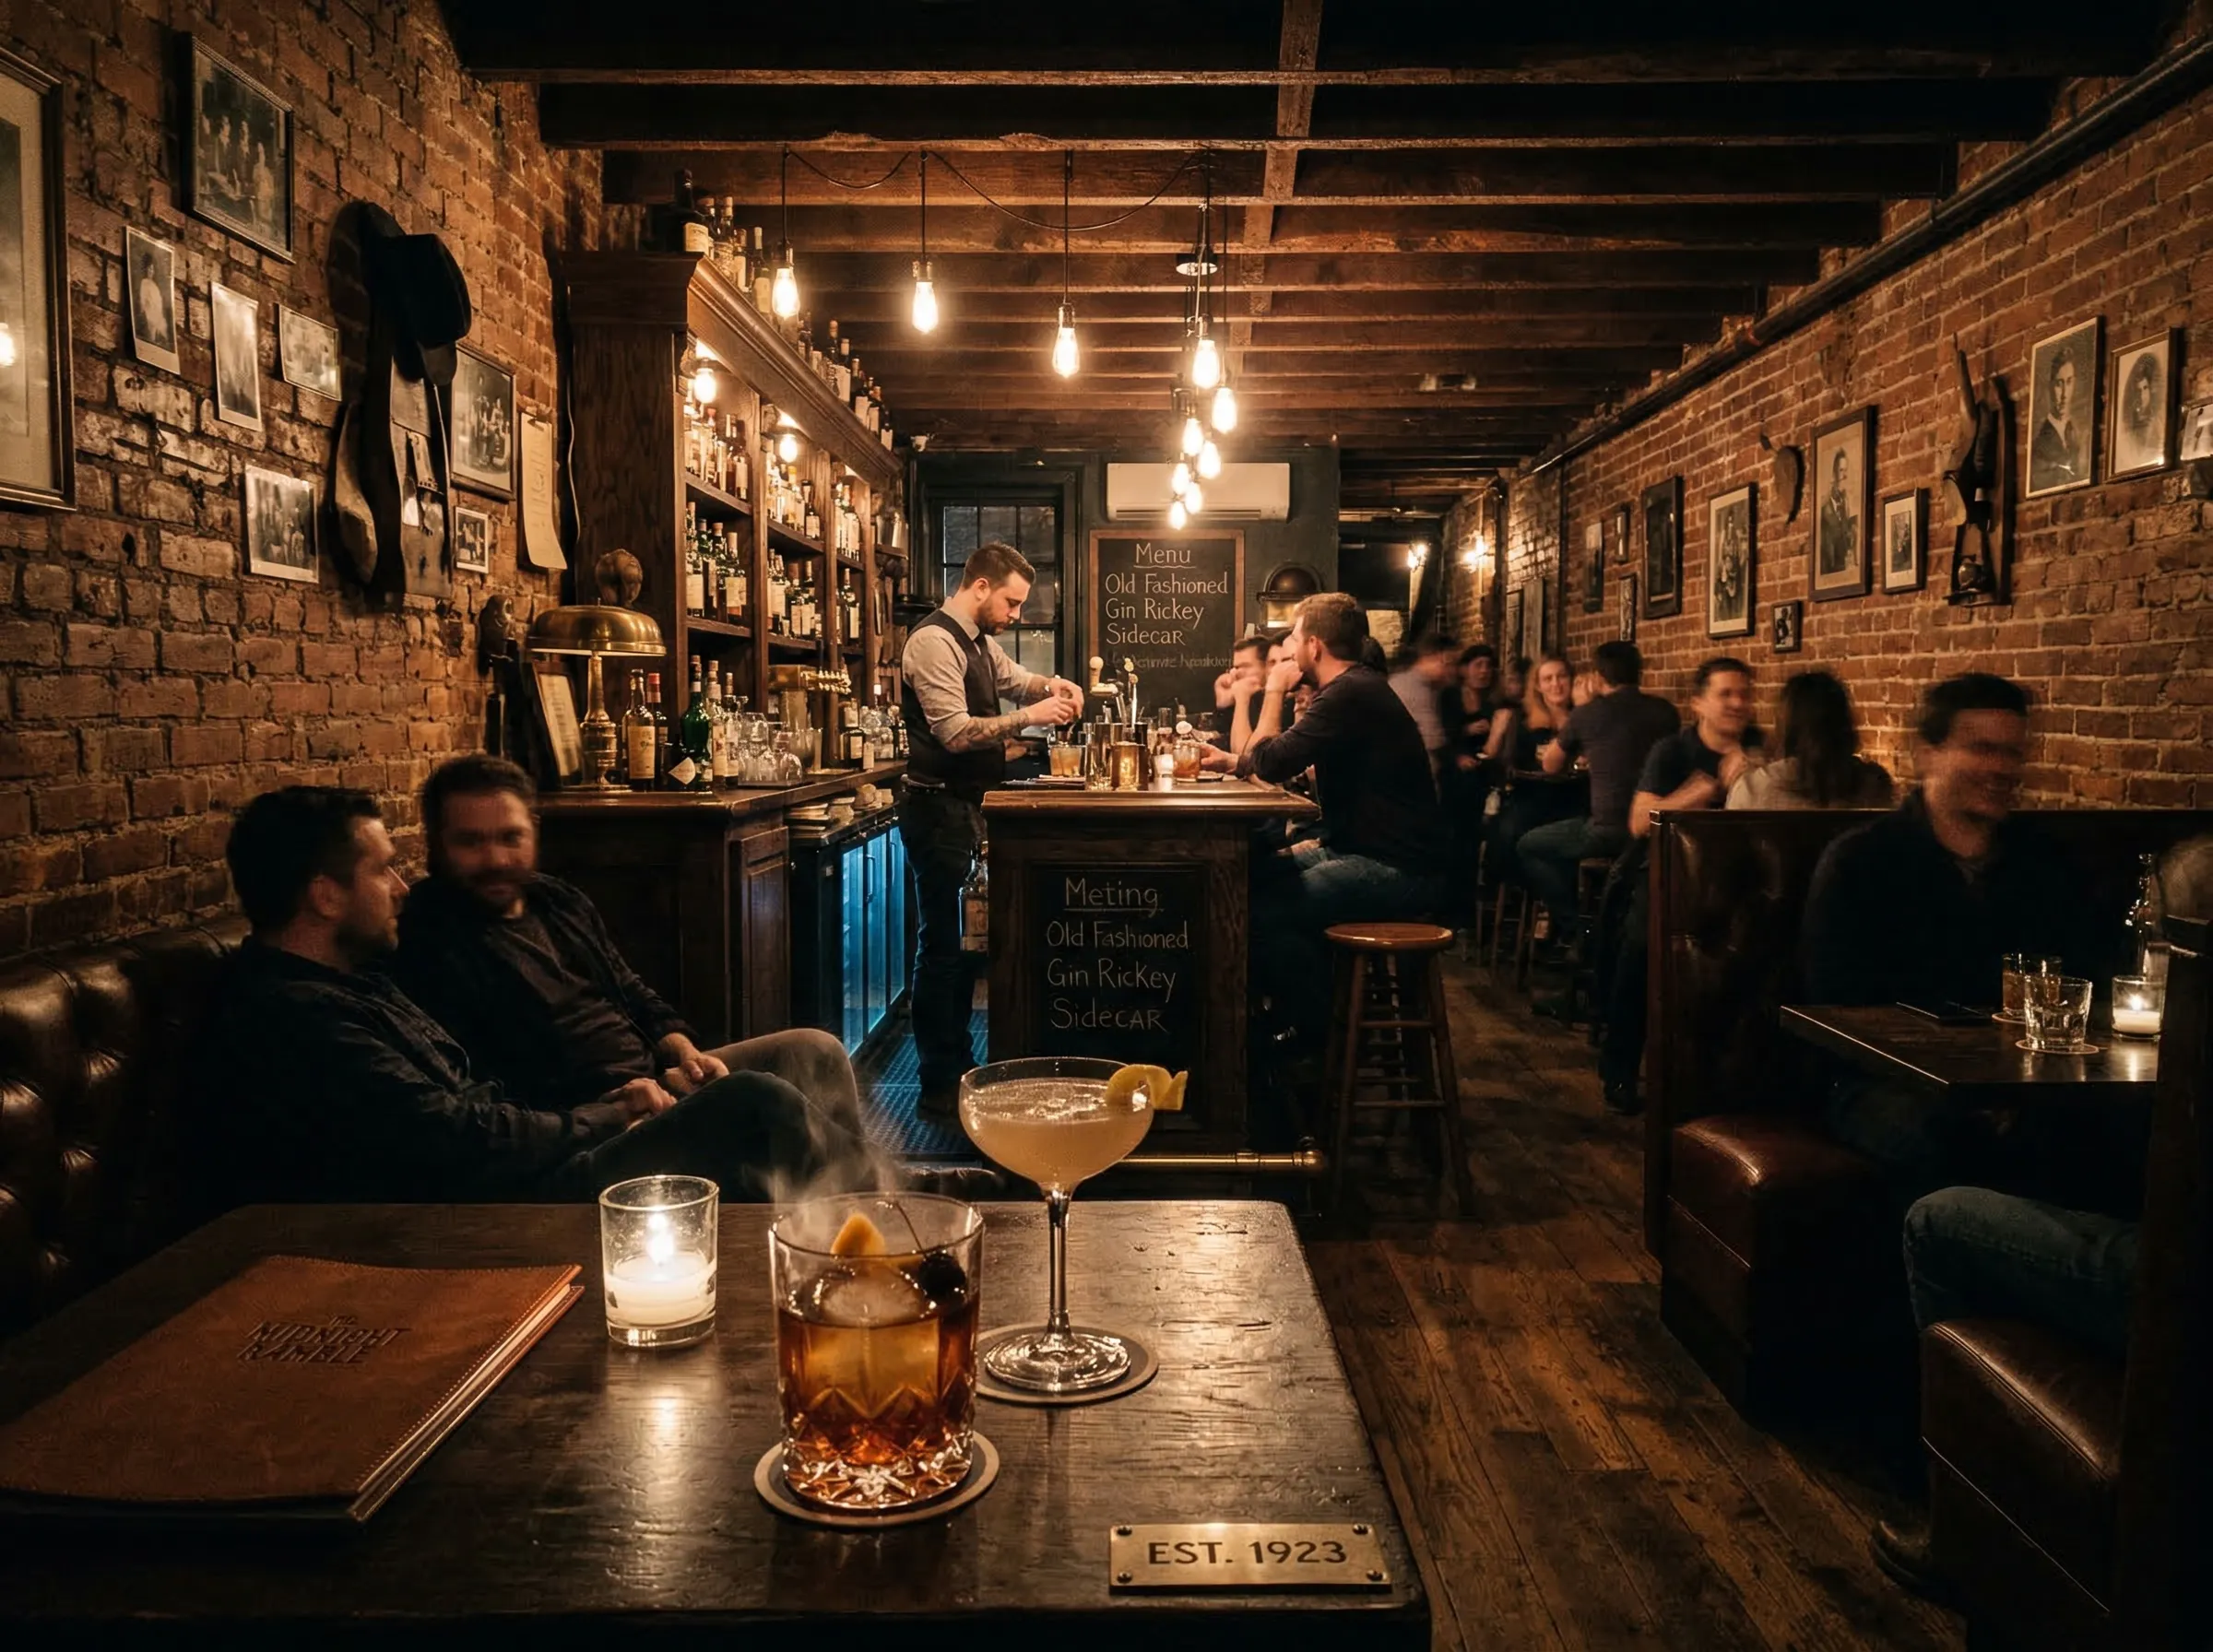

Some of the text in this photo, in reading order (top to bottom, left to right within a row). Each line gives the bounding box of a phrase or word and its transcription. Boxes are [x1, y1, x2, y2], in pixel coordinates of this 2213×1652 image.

[1135, 542, 1191, 564] Menu
[1106, 572, 1228, 595] Old Fashioned
[1106, 598, 1204, 630] Gin Rickey
[1065, 877, 1159, 918] Meting
[1047, 920, 1189, 950] Old Fashioned
[1047, 958, 1089, 988] Gin
[1147, 1540, 1348, 1565] EST. 1923
